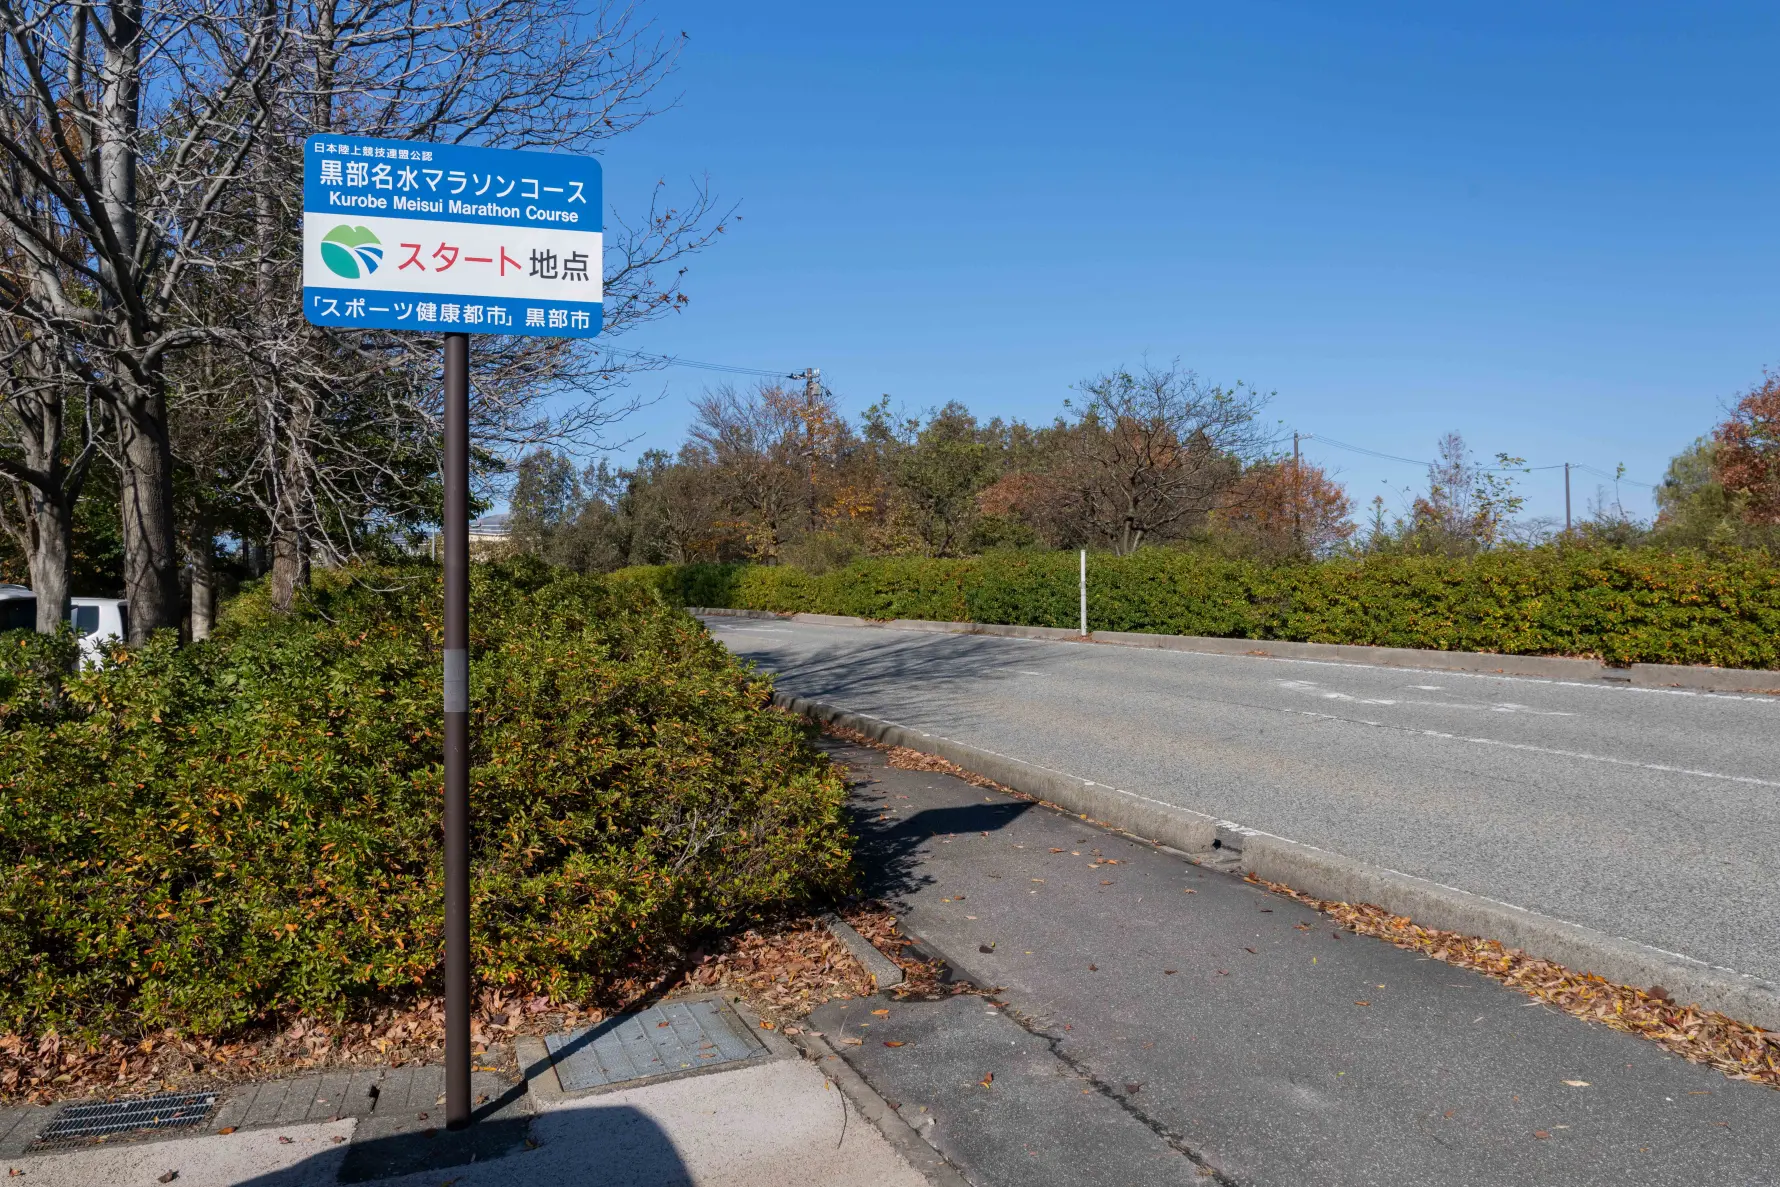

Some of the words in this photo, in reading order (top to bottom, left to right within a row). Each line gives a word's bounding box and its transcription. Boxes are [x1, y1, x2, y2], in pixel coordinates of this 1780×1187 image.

[314, 142, 433, 162] 日本陸上競技連盟公認
[320, 159, 587, 204] 黒部名水マラソンコース
[329, 190, 388, 209] Kurobe
[393, 195, 443, 213] Meisui
[448, 199, 520, 219] Marathon
[525, 205, 579, 223] Course
